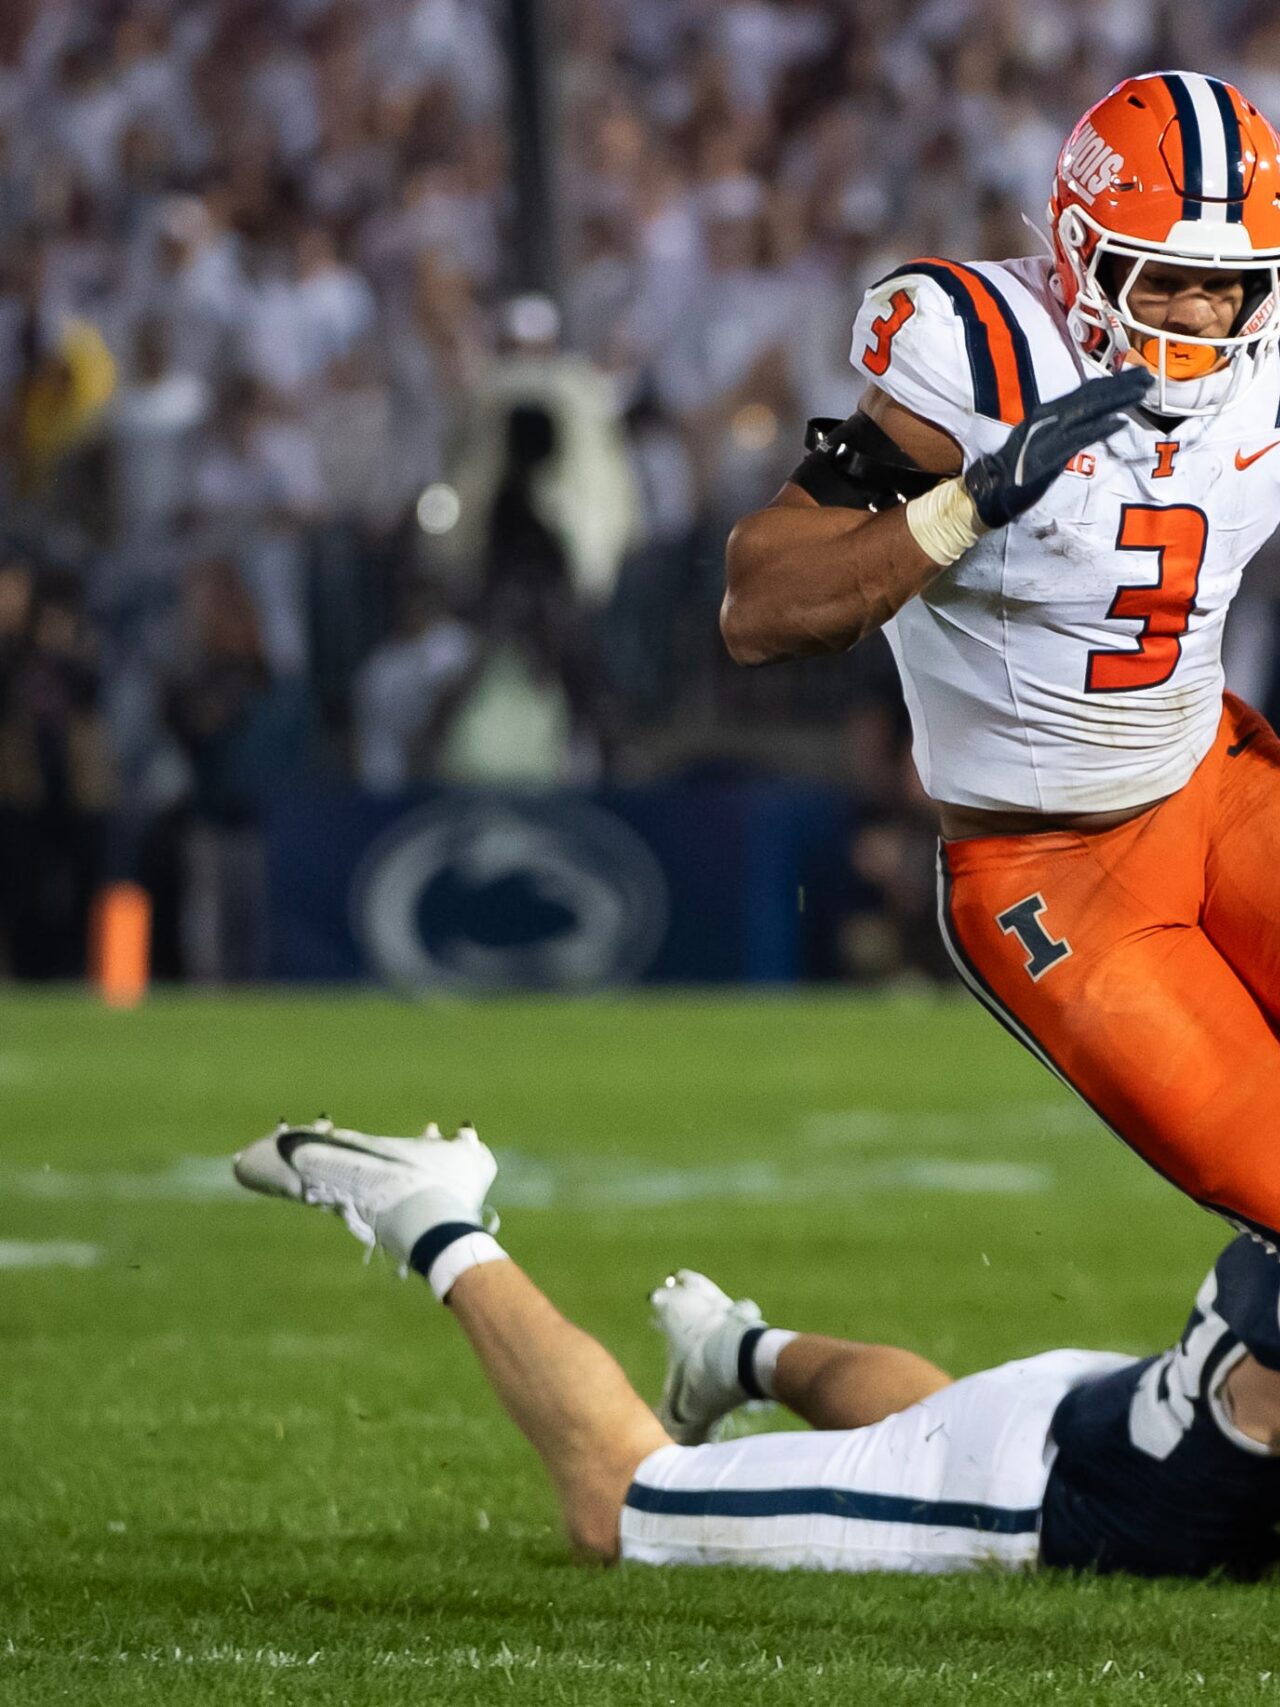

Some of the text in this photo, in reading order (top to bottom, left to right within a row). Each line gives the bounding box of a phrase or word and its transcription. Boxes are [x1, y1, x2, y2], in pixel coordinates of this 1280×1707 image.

[862, 289, 915, 376] 3
[1151, 441, 1180, 478] I
[1084, 503, 1209, 694] 3
[995, 891, 1073, 983] I
